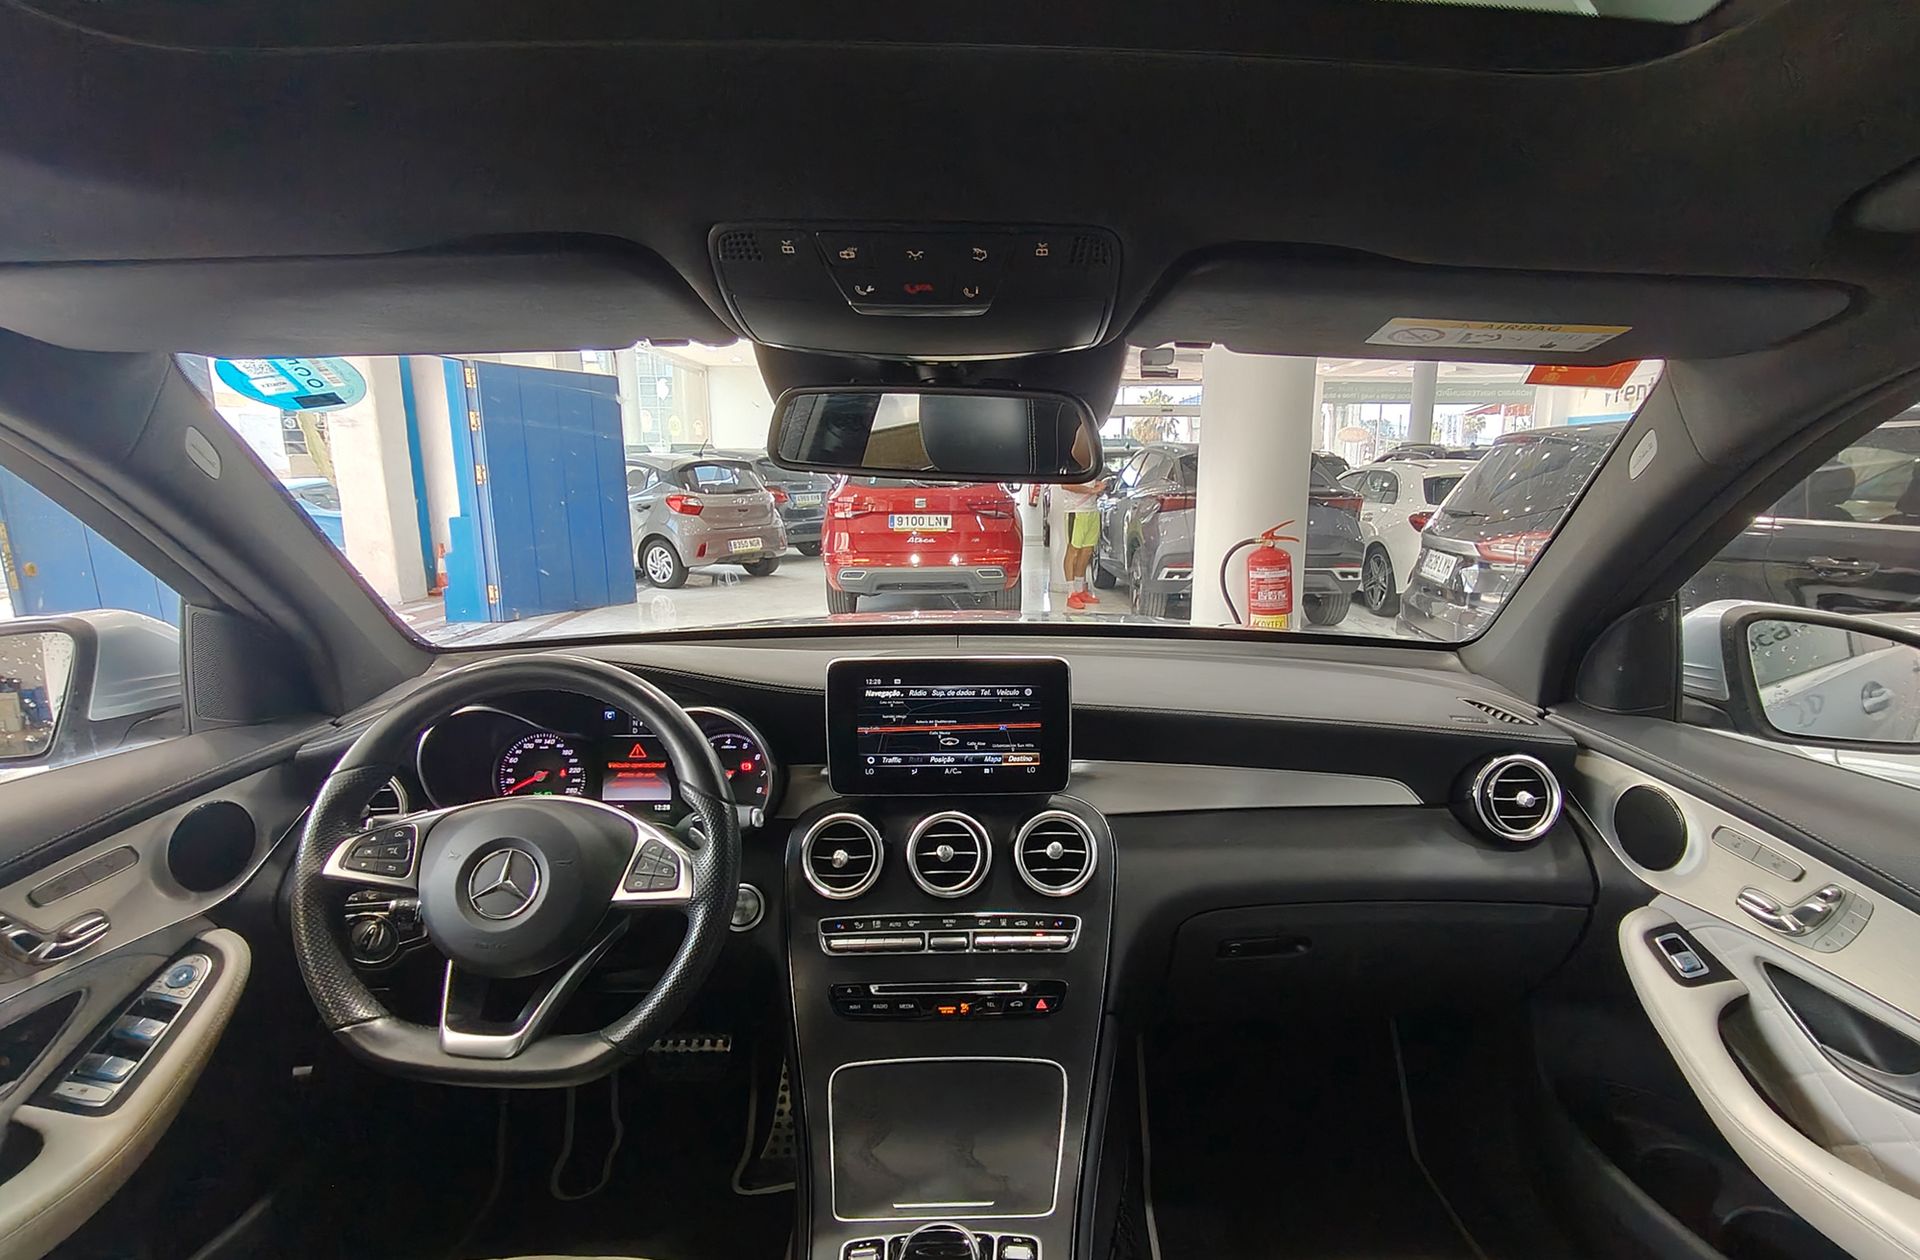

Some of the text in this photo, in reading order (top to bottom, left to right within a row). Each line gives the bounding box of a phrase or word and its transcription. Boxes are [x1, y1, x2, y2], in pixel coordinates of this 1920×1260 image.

[1483, 324, 1563, 332] AIRBAG
[897, 516, 925, 527] 9100
[909, 689, 927, 697] Rádio
[931, 689, 945, 698] Sup.
[980, 688, 991, 696] Tel.
[882, 756, 902, 764] Traffic
[930, 755, 955, 764] Posição
[984, 756, 1002, 764] Mapa
